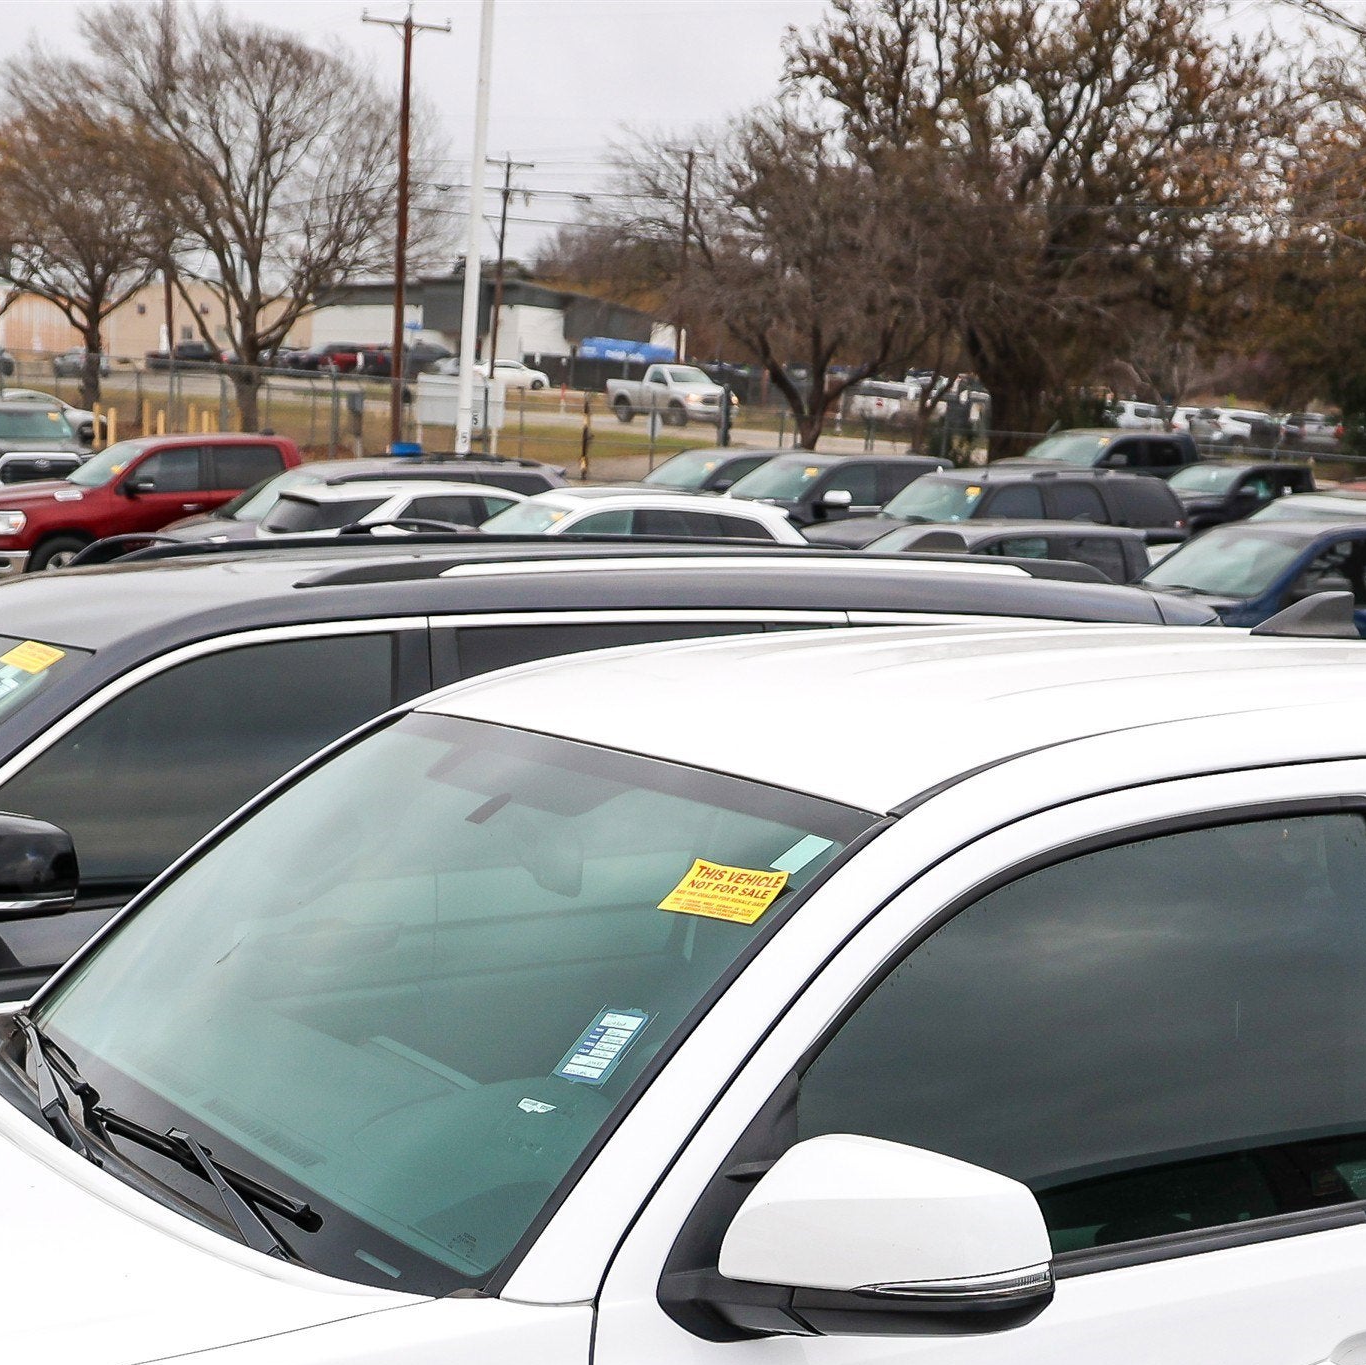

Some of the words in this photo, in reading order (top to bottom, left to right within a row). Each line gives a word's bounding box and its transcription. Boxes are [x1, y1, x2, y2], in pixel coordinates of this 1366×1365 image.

[695, 865, 727, 881] THIS
[727, 871, 784, 889] VEHICLE
[688, 879, 714, 890] NOT
[712, 883, 738, 895] FOR
[738, 888, 772, 900] SALE
